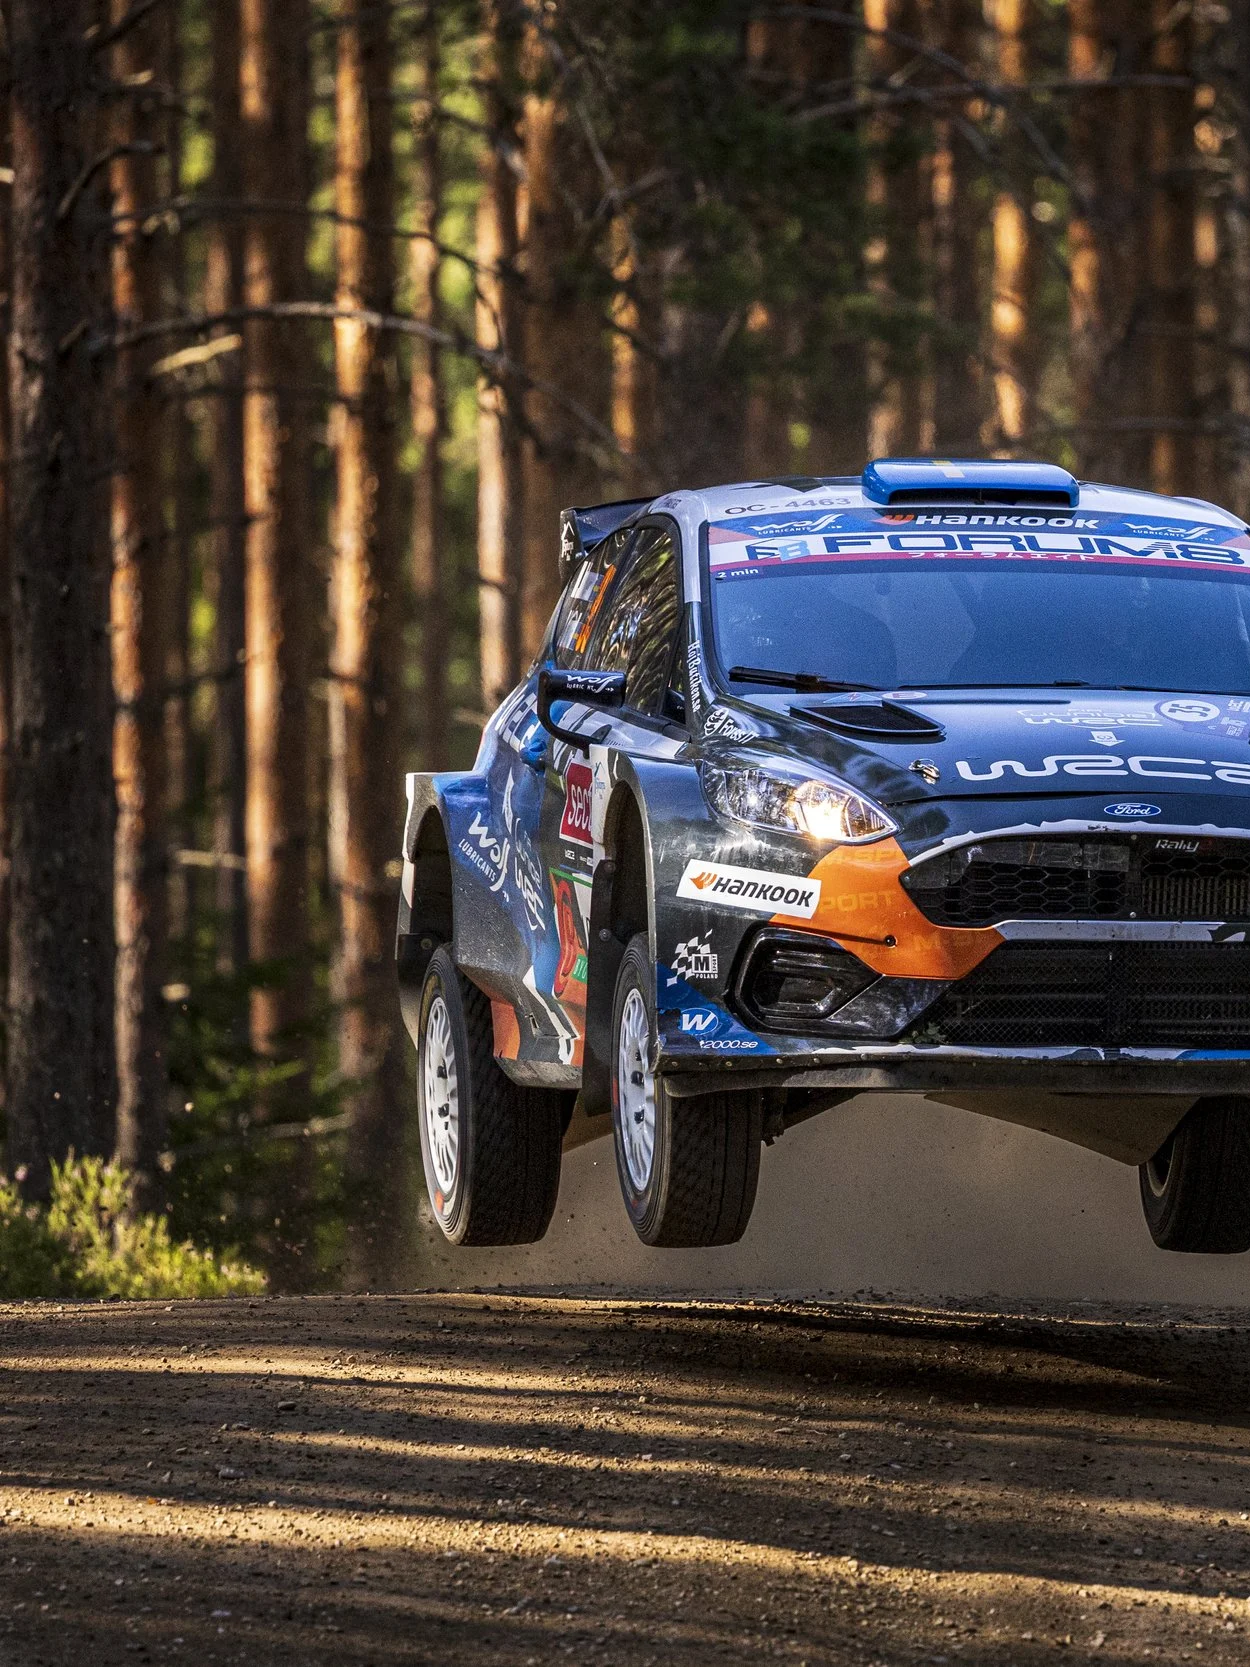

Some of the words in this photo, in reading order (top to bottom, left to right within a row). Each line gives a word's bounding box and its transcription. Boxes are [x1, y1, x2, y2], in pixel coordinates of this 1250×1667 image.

[823, 534, 1246, 565] FORUM8
[730, 567, 759, 577] min
[1113, 803, 1151, 816] Ford
[458, 838, 497, 882] LUBRICANTS
